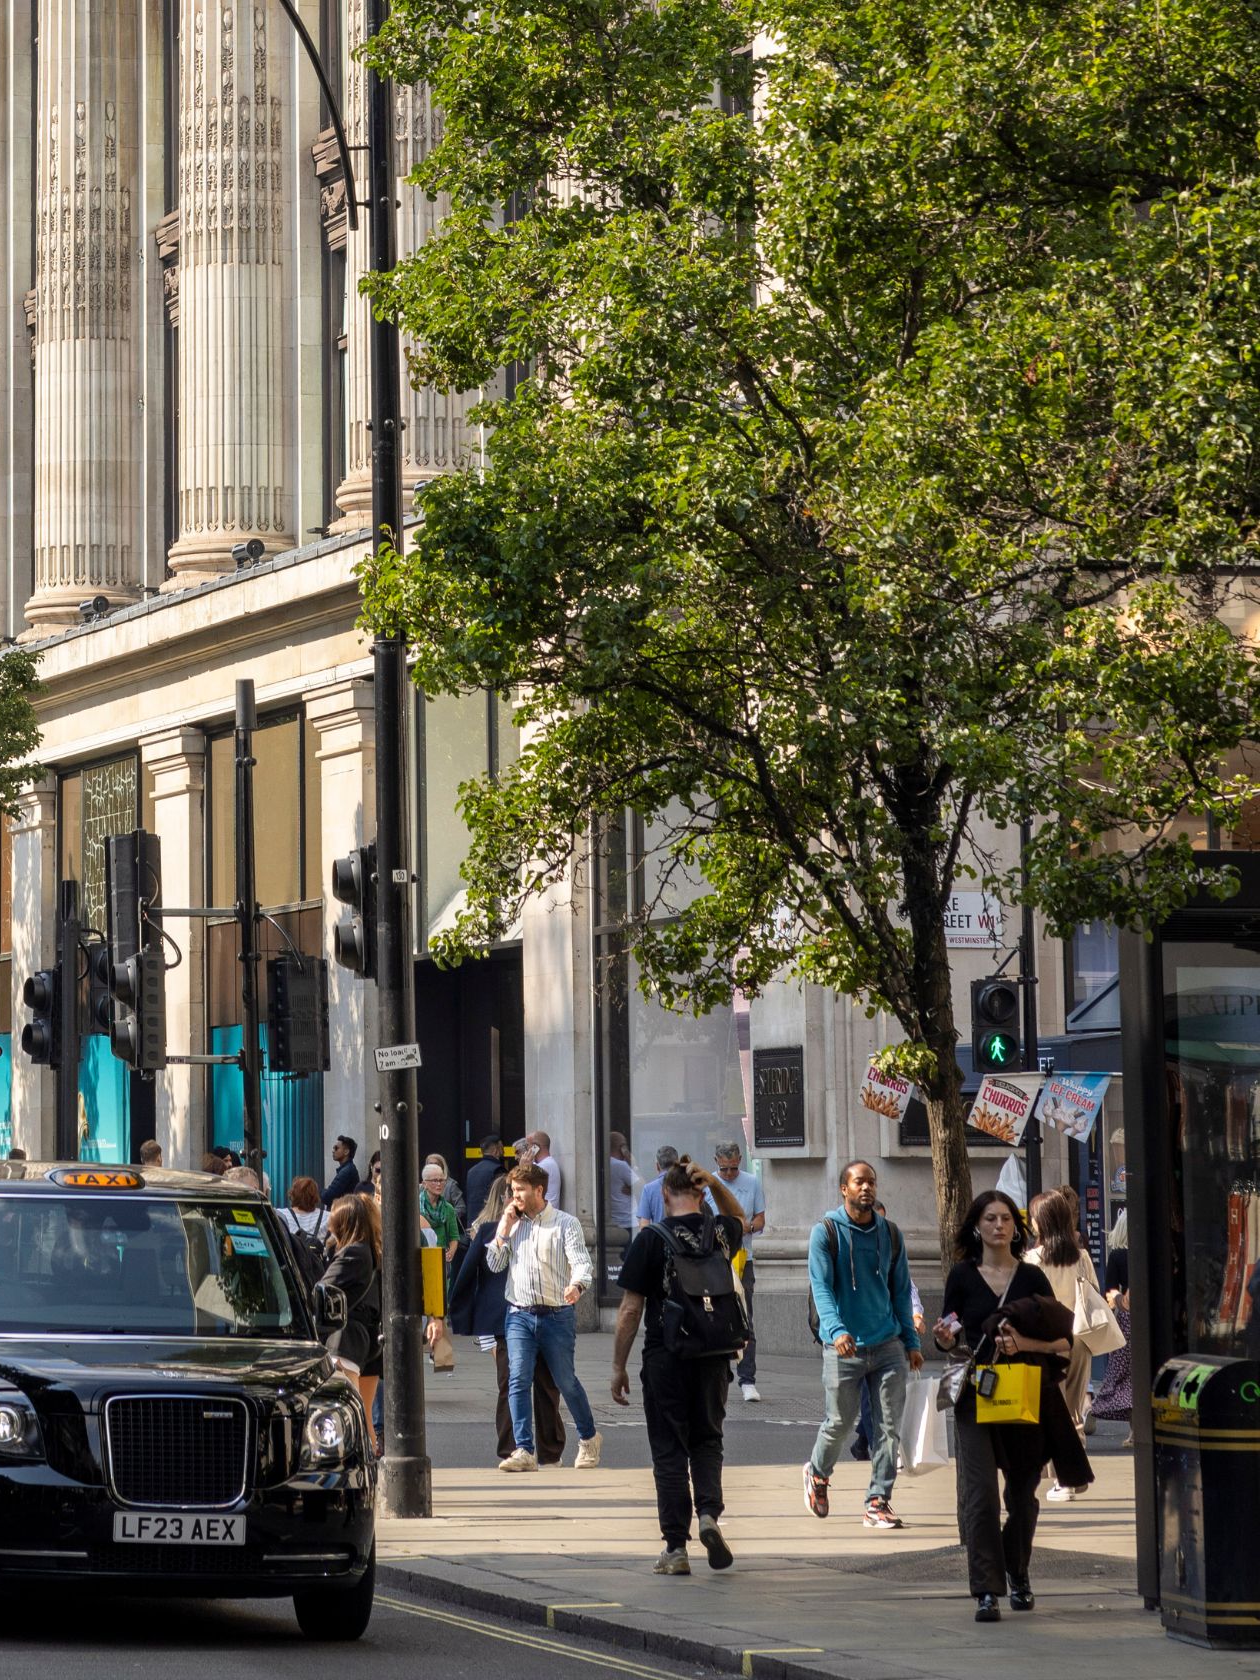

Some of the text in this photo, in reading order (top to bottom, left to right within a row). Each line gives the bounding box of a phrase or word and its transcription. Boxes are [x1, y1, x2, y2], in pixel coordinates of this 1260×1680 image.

[943, 915, 971, 928] REET
[949, 937, 990, 945] WESTMINSTER
[982, 1086, 1027, 1117] CHURROS
[1050, 1082, 1095, 1111] ICE CREAM
[70, 1174, 131, 1185] TAXI
[122, 1516, 235, 1541] LF23 AEX
